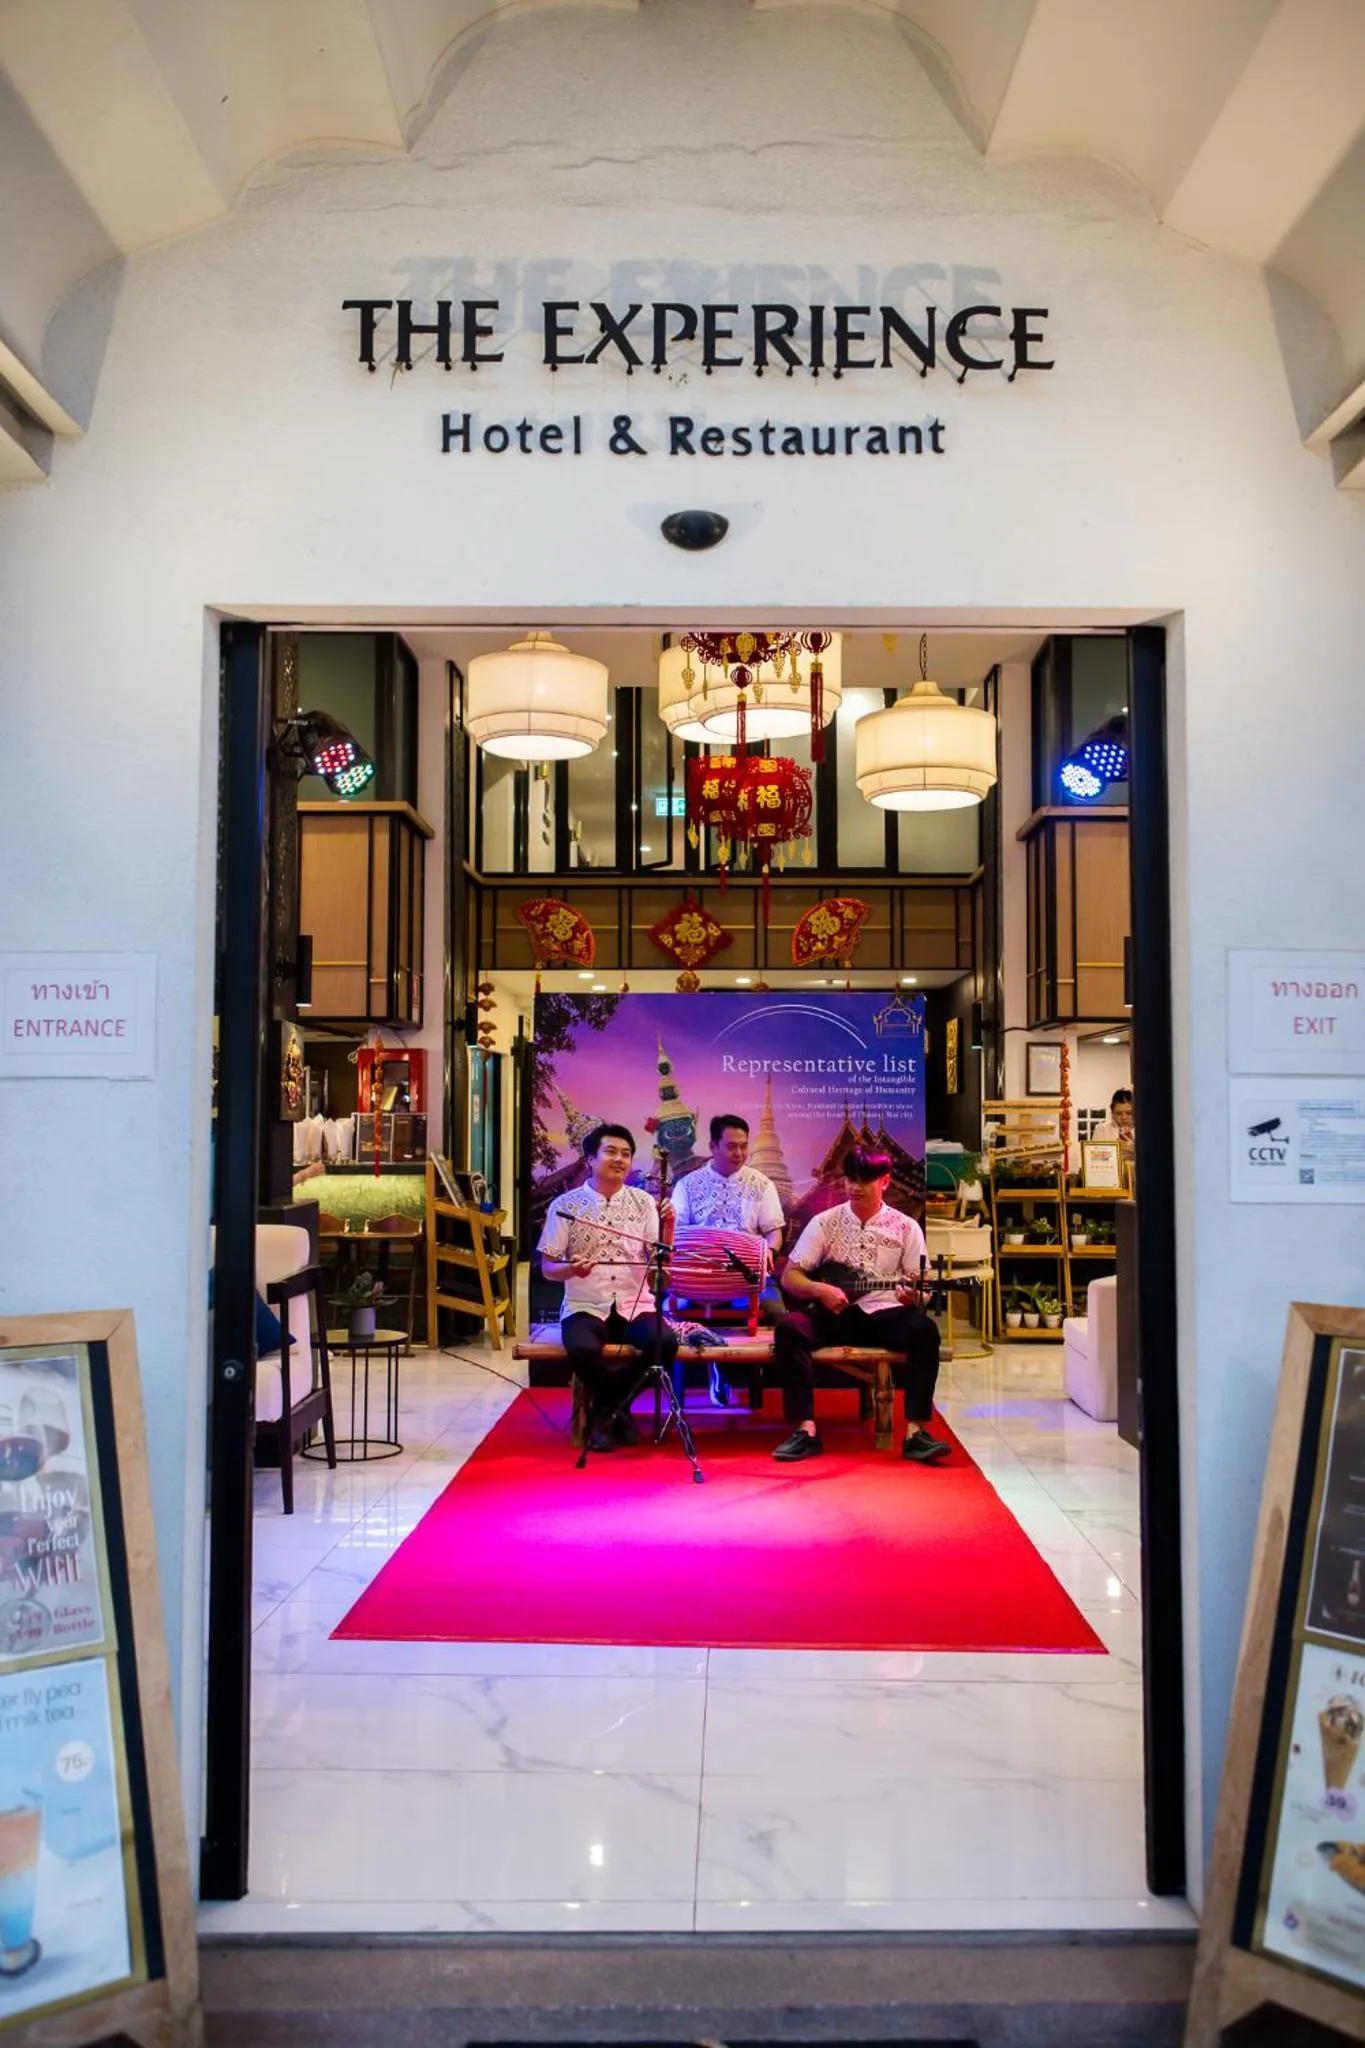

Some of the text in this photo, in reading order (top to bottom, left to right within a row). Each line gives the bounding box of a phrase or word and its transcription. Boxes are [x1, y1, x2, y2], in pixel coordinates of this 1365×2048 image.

[342, 300, 1056, 370] THE EXPERIENCE
[441, 413, 947, 456] Hotel & Restaurant
[31, 979, 110, 1000] ทางเข้า
[1270, 981, 1359, 998] ทางออก
[13, 1019, 127, 1038] ENTRANCE
[1294, 1016, 1339, 1035] EXIT
[721, 1053, 917, 1078] Representative list
[858, 1075, 872, 1083] the
[874, 1075, 916, 1085] Intangible
[791, 1085, 826, 1094] Cultural
[828, 1085, 862, 1096] Heritage
[875, 1085, 917, 1096] Humanity
[1248, 1147, 1286, 1161] CCTV
[46, 1683, 82, 1707] pea
[45, 1705, 75, 1723] tea
